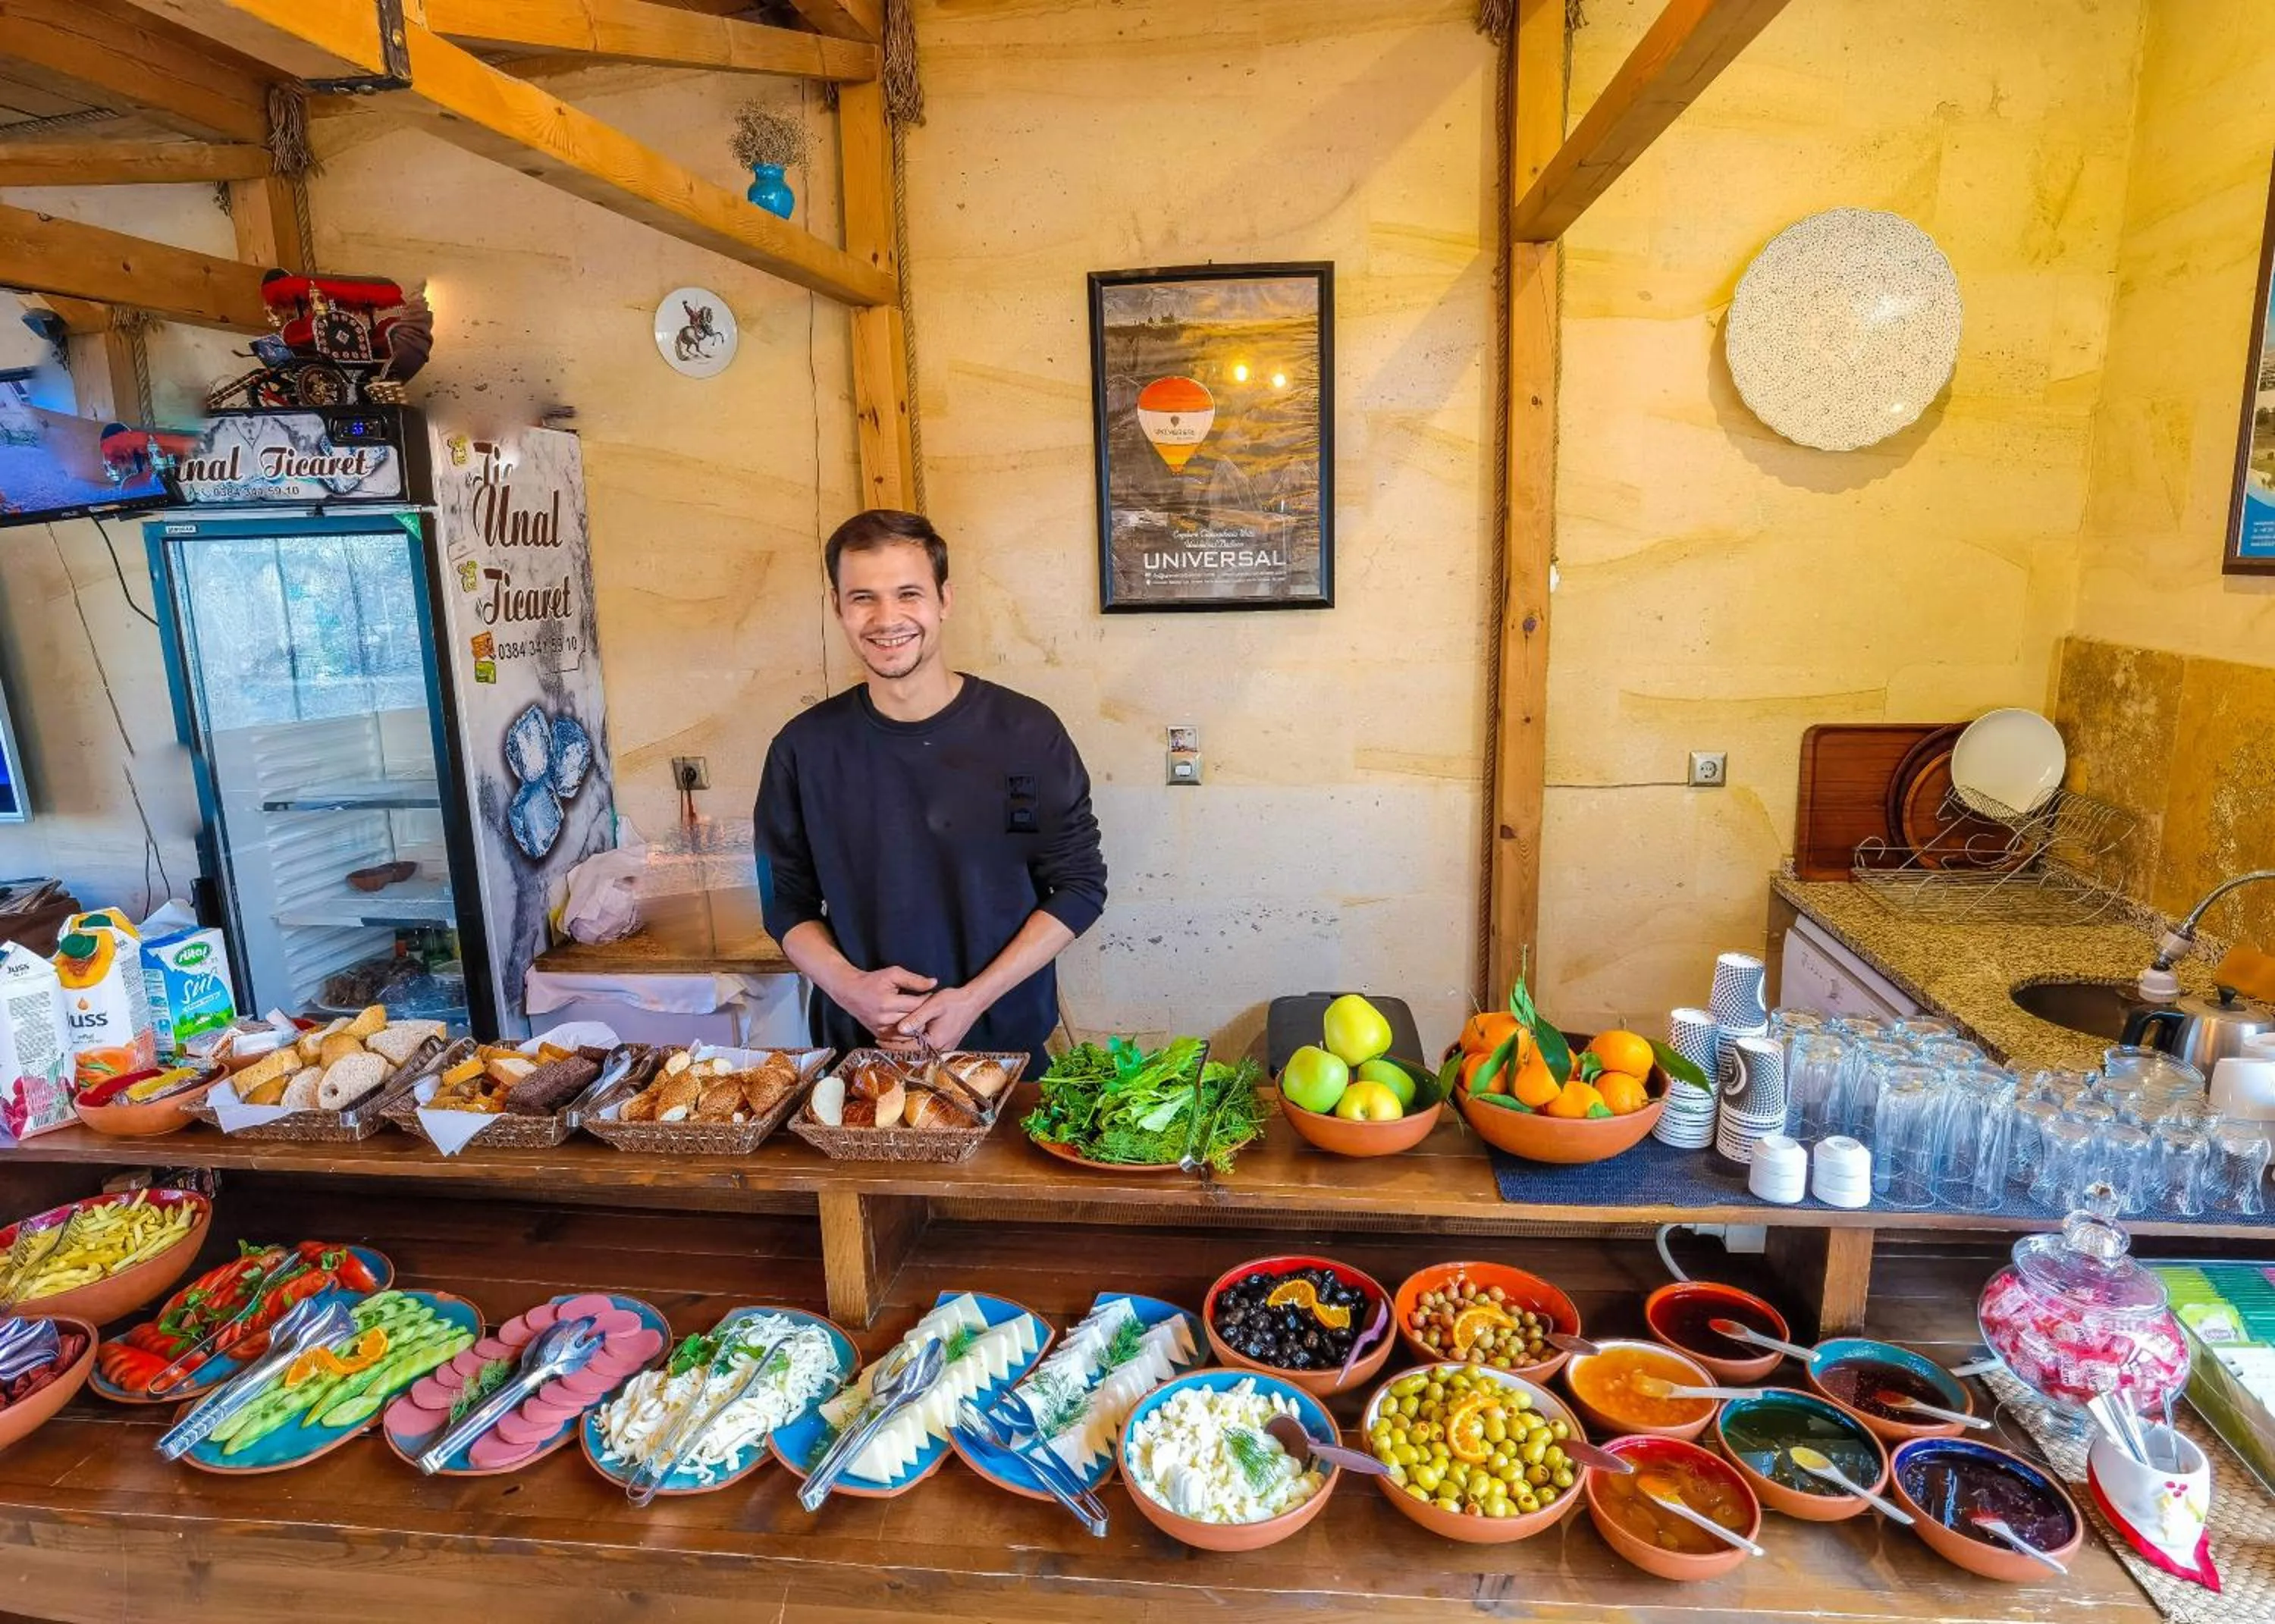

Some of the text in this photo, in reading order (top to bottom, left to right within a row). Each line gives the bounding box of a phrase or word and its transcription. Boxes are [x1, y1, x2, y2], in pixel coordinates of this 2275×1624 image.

[259, 447, 368, 478] Ticaret
[1144, 550, 1286, 569] UNIVERSAL
[483, 569, 573, 625] Ticaret
[498, 641, 526, 660] 0384
[566, 636, 577, 651] 10
